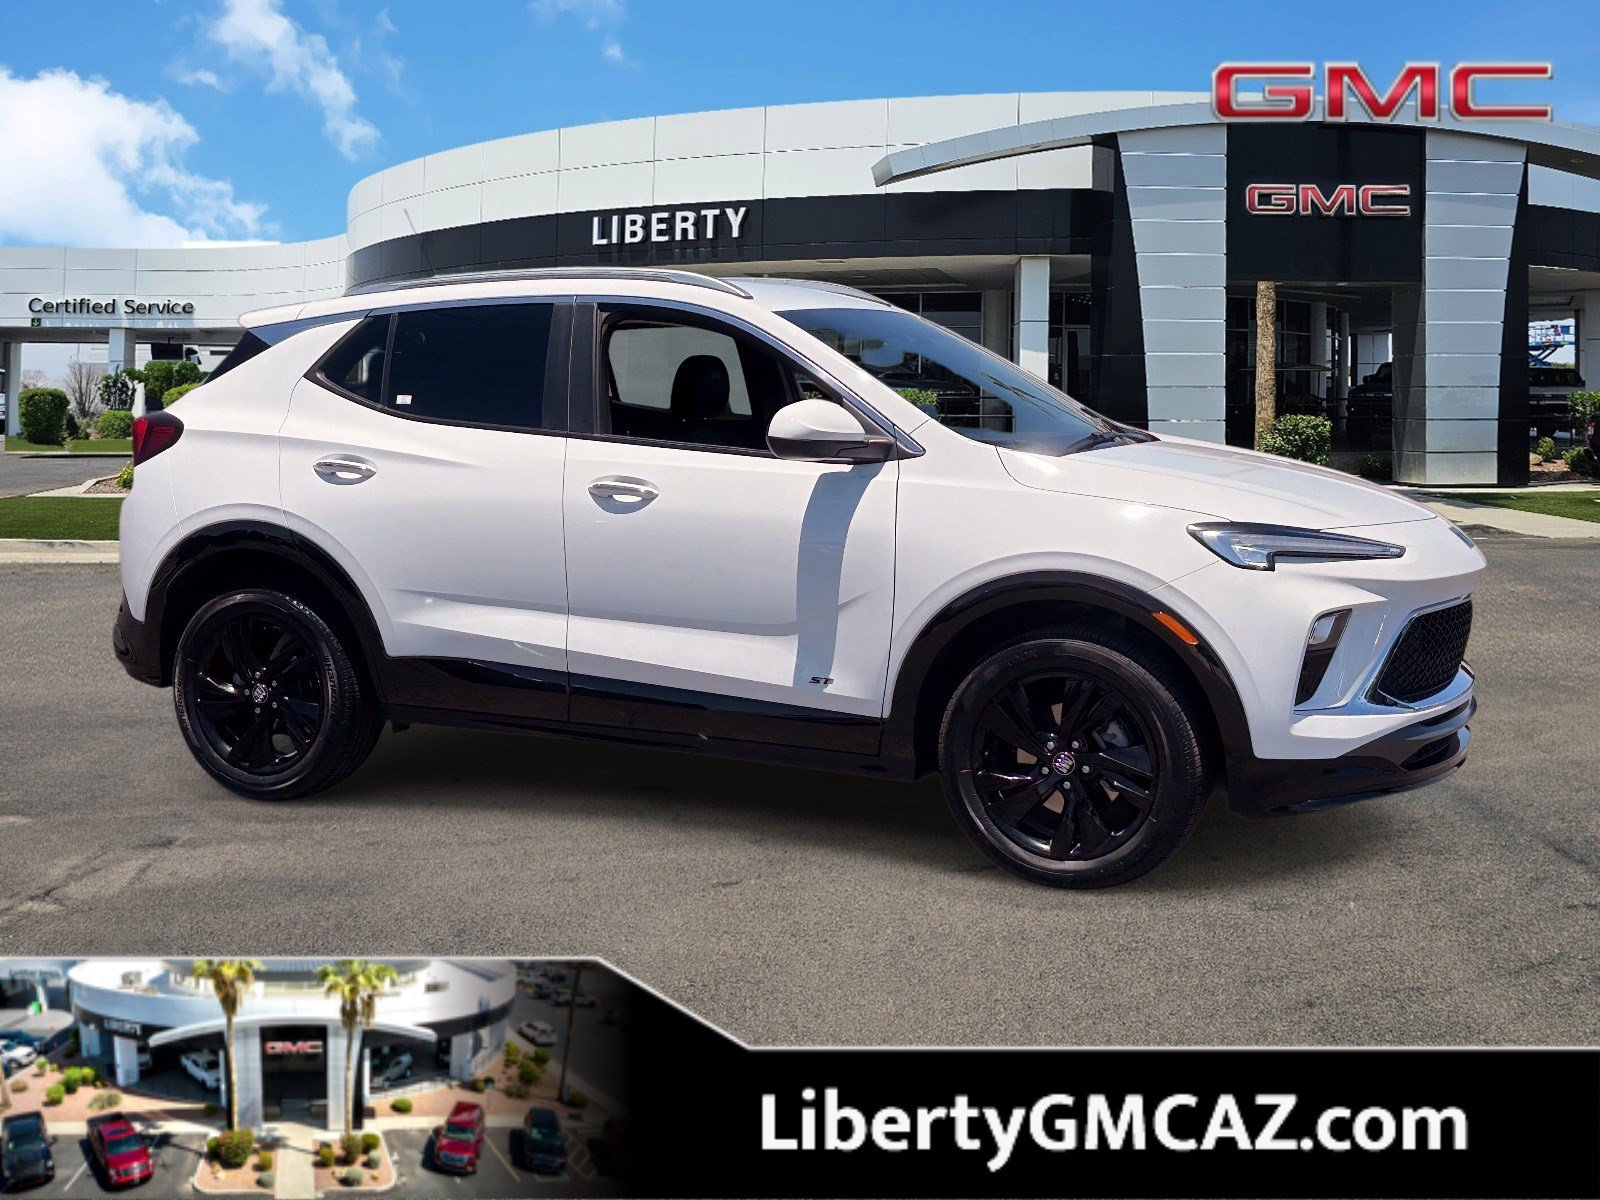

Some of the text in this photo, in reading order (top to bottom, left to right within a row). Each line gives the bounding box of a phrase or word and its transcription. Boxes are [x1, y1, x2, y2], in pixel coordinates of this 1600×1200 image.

[1245, 183, 1412, 217] GMC
[592, 206, 748, 246] LIBERTY
[28, 297, 195, 315] Certified Service
[808, 676, 834, 684] ST
